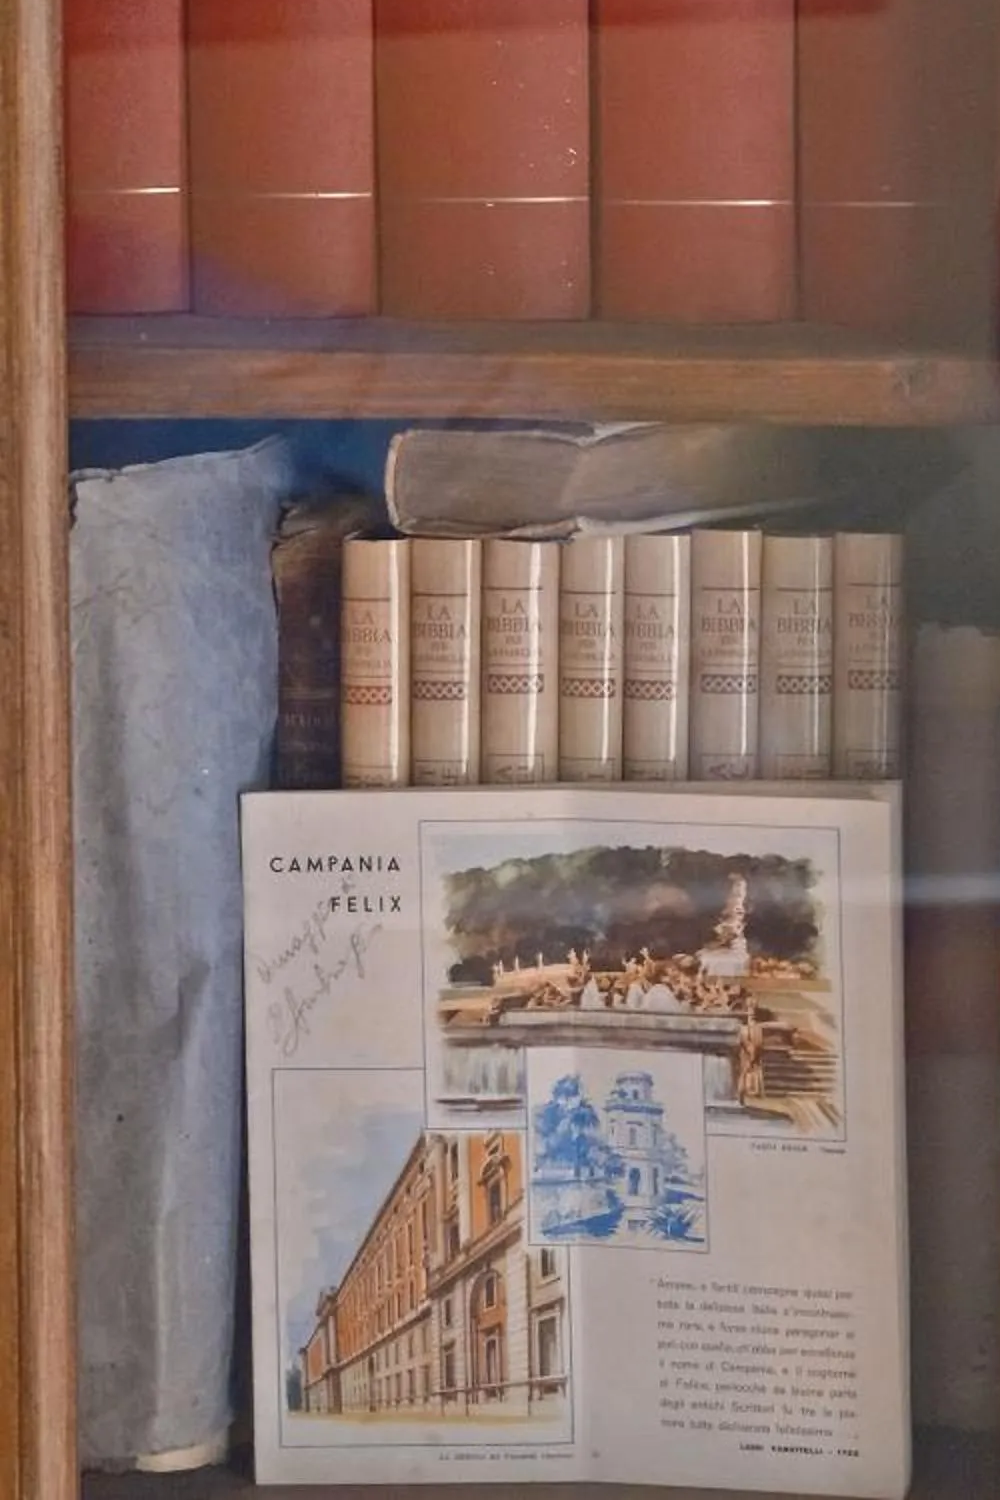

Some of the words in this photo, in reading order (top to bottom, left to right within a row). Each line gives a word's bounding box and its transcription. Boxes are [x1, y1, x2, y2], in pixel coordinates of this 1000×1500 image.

[701, 616, 757, 632] BIBBIA
[777, 616, 832, 633] BIBBIA
[269, 856, 402, 874] CAMPANIA
[329, 895, 403, 913] FELIX
